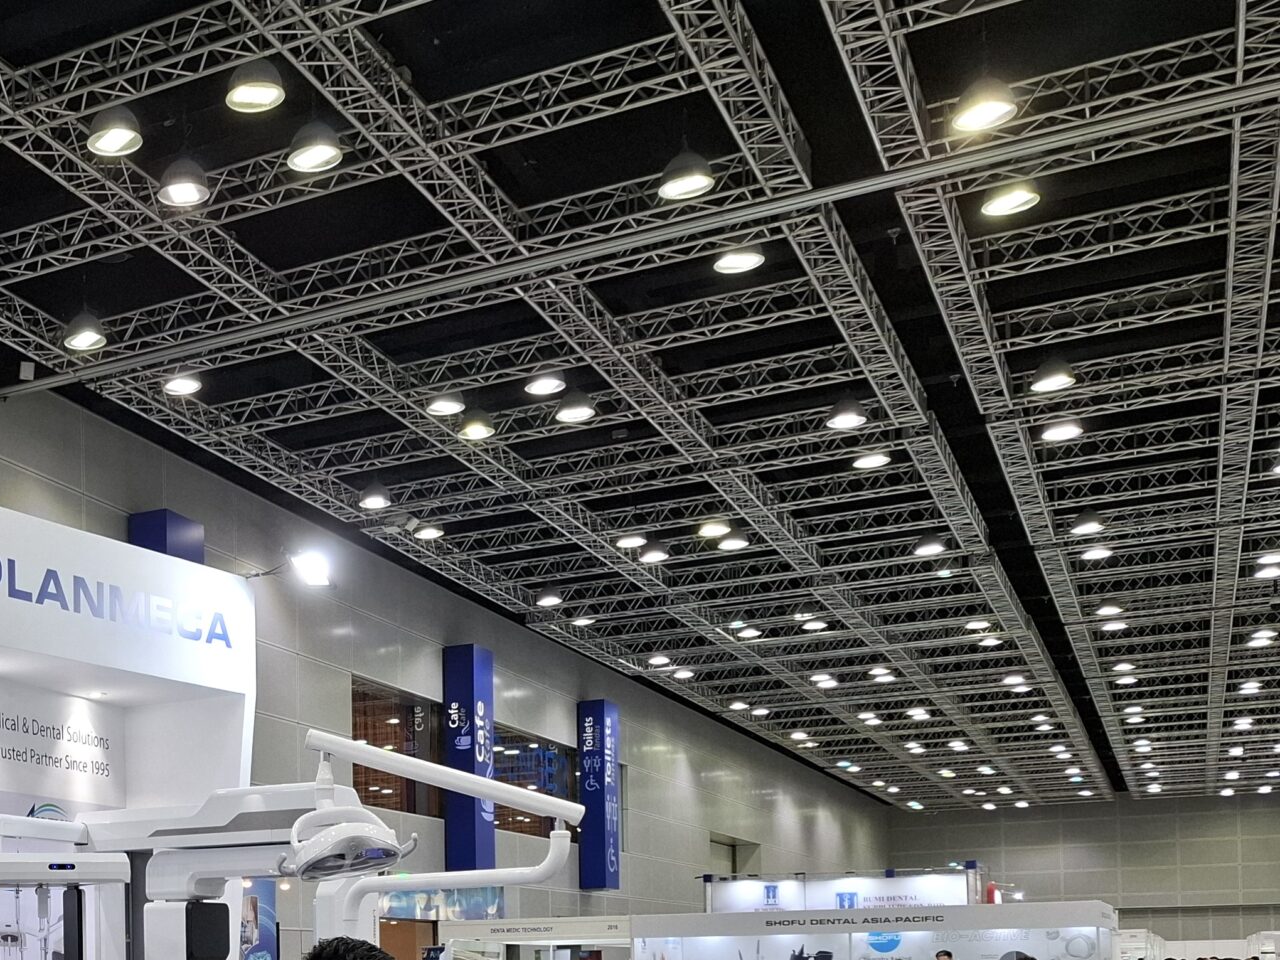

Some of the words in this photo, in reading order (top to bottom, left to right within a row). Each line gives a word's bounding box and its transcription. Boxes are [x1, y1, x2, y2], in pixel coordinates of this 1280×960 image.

[448, 702, 459, 728] Cafe
[22, 719, 30, 734] &
[31, 719, 64, 741] Dental
[66, 726, 110, 750] Solutions
[475, 701, 485, 763] Cafe
[583, 716, 594, 752] Toilets
[30, 748, 63, 769] Partner
[64, 754, 88, 773] Since
[90, 760, 110, 777] 1995
[765, 919, 806, 927] SHOFU
[810, 918, 858, 926] DENTAL
[862, 915, 945, 924] ASIA-PACIFIC
